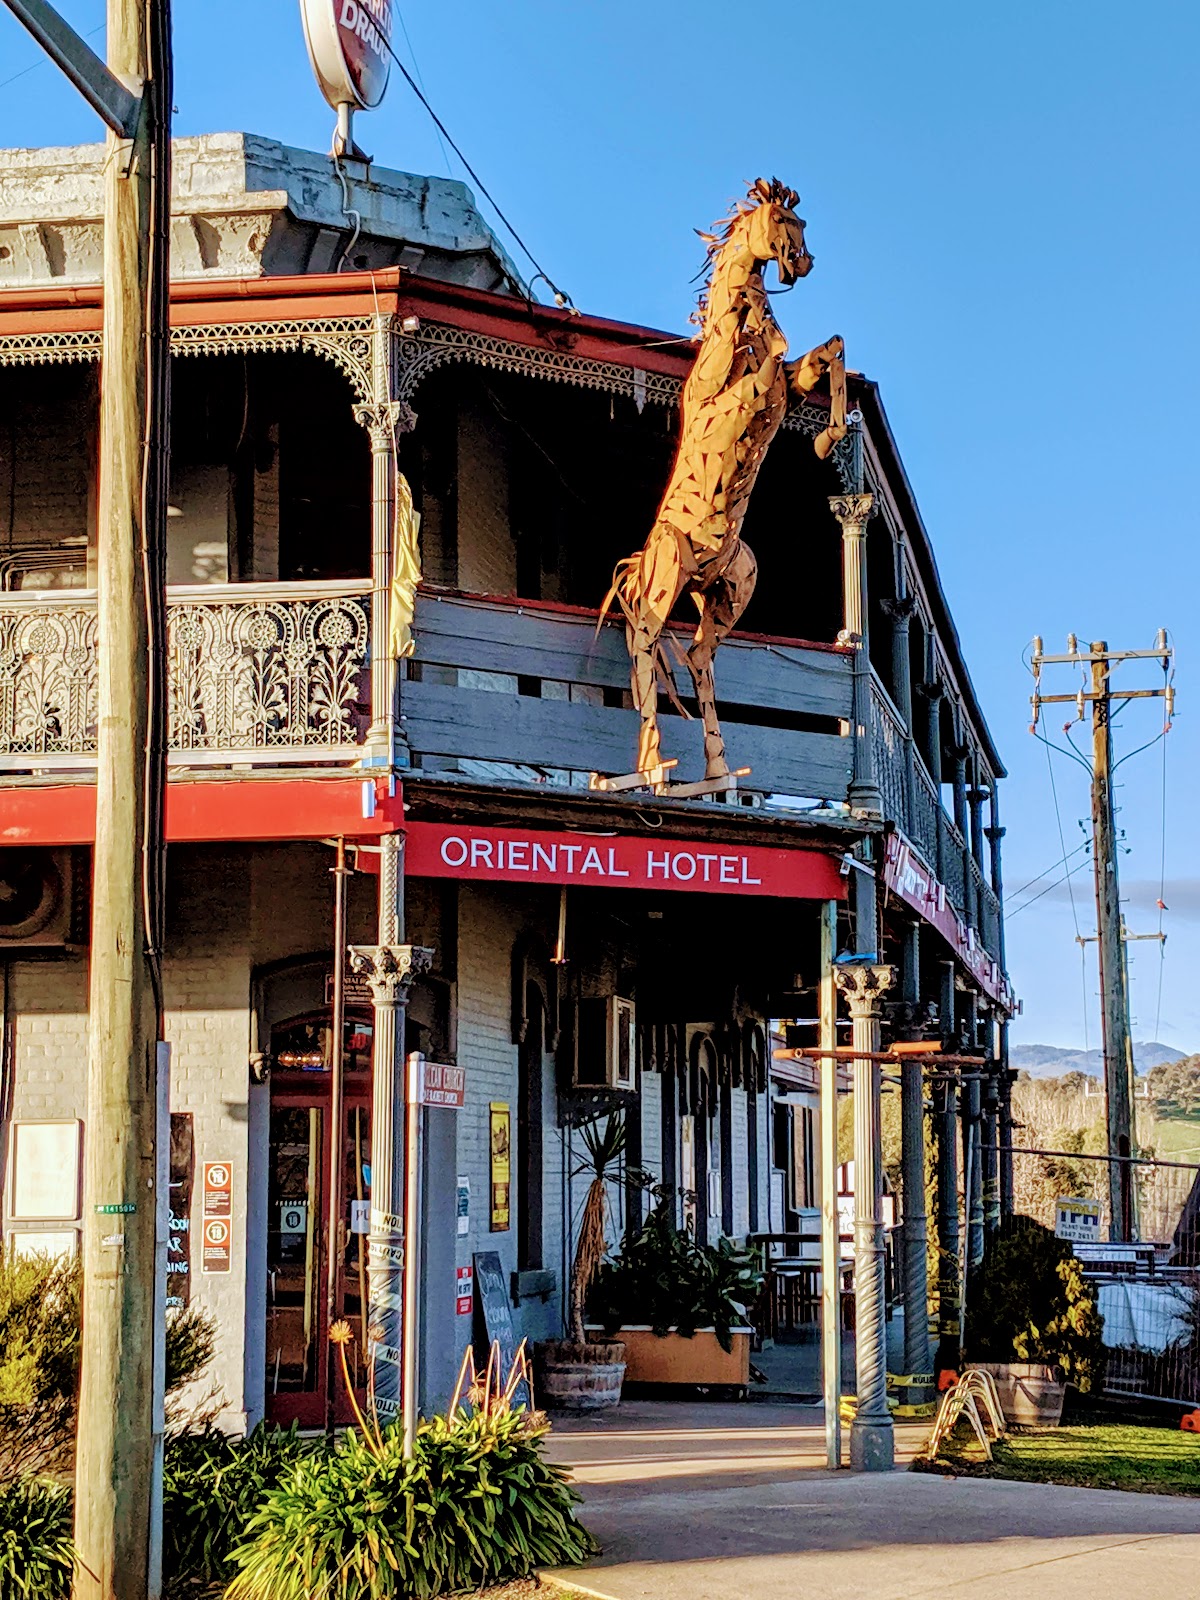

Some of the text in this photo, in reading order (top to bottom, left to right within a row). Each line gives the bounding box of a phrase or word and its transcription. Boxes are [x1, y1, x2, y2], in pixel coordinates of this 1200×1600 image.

[441, 836, 761, 885] ORIENTAL HOTEL
[1057, 1202, 1099, 1227] TPH
